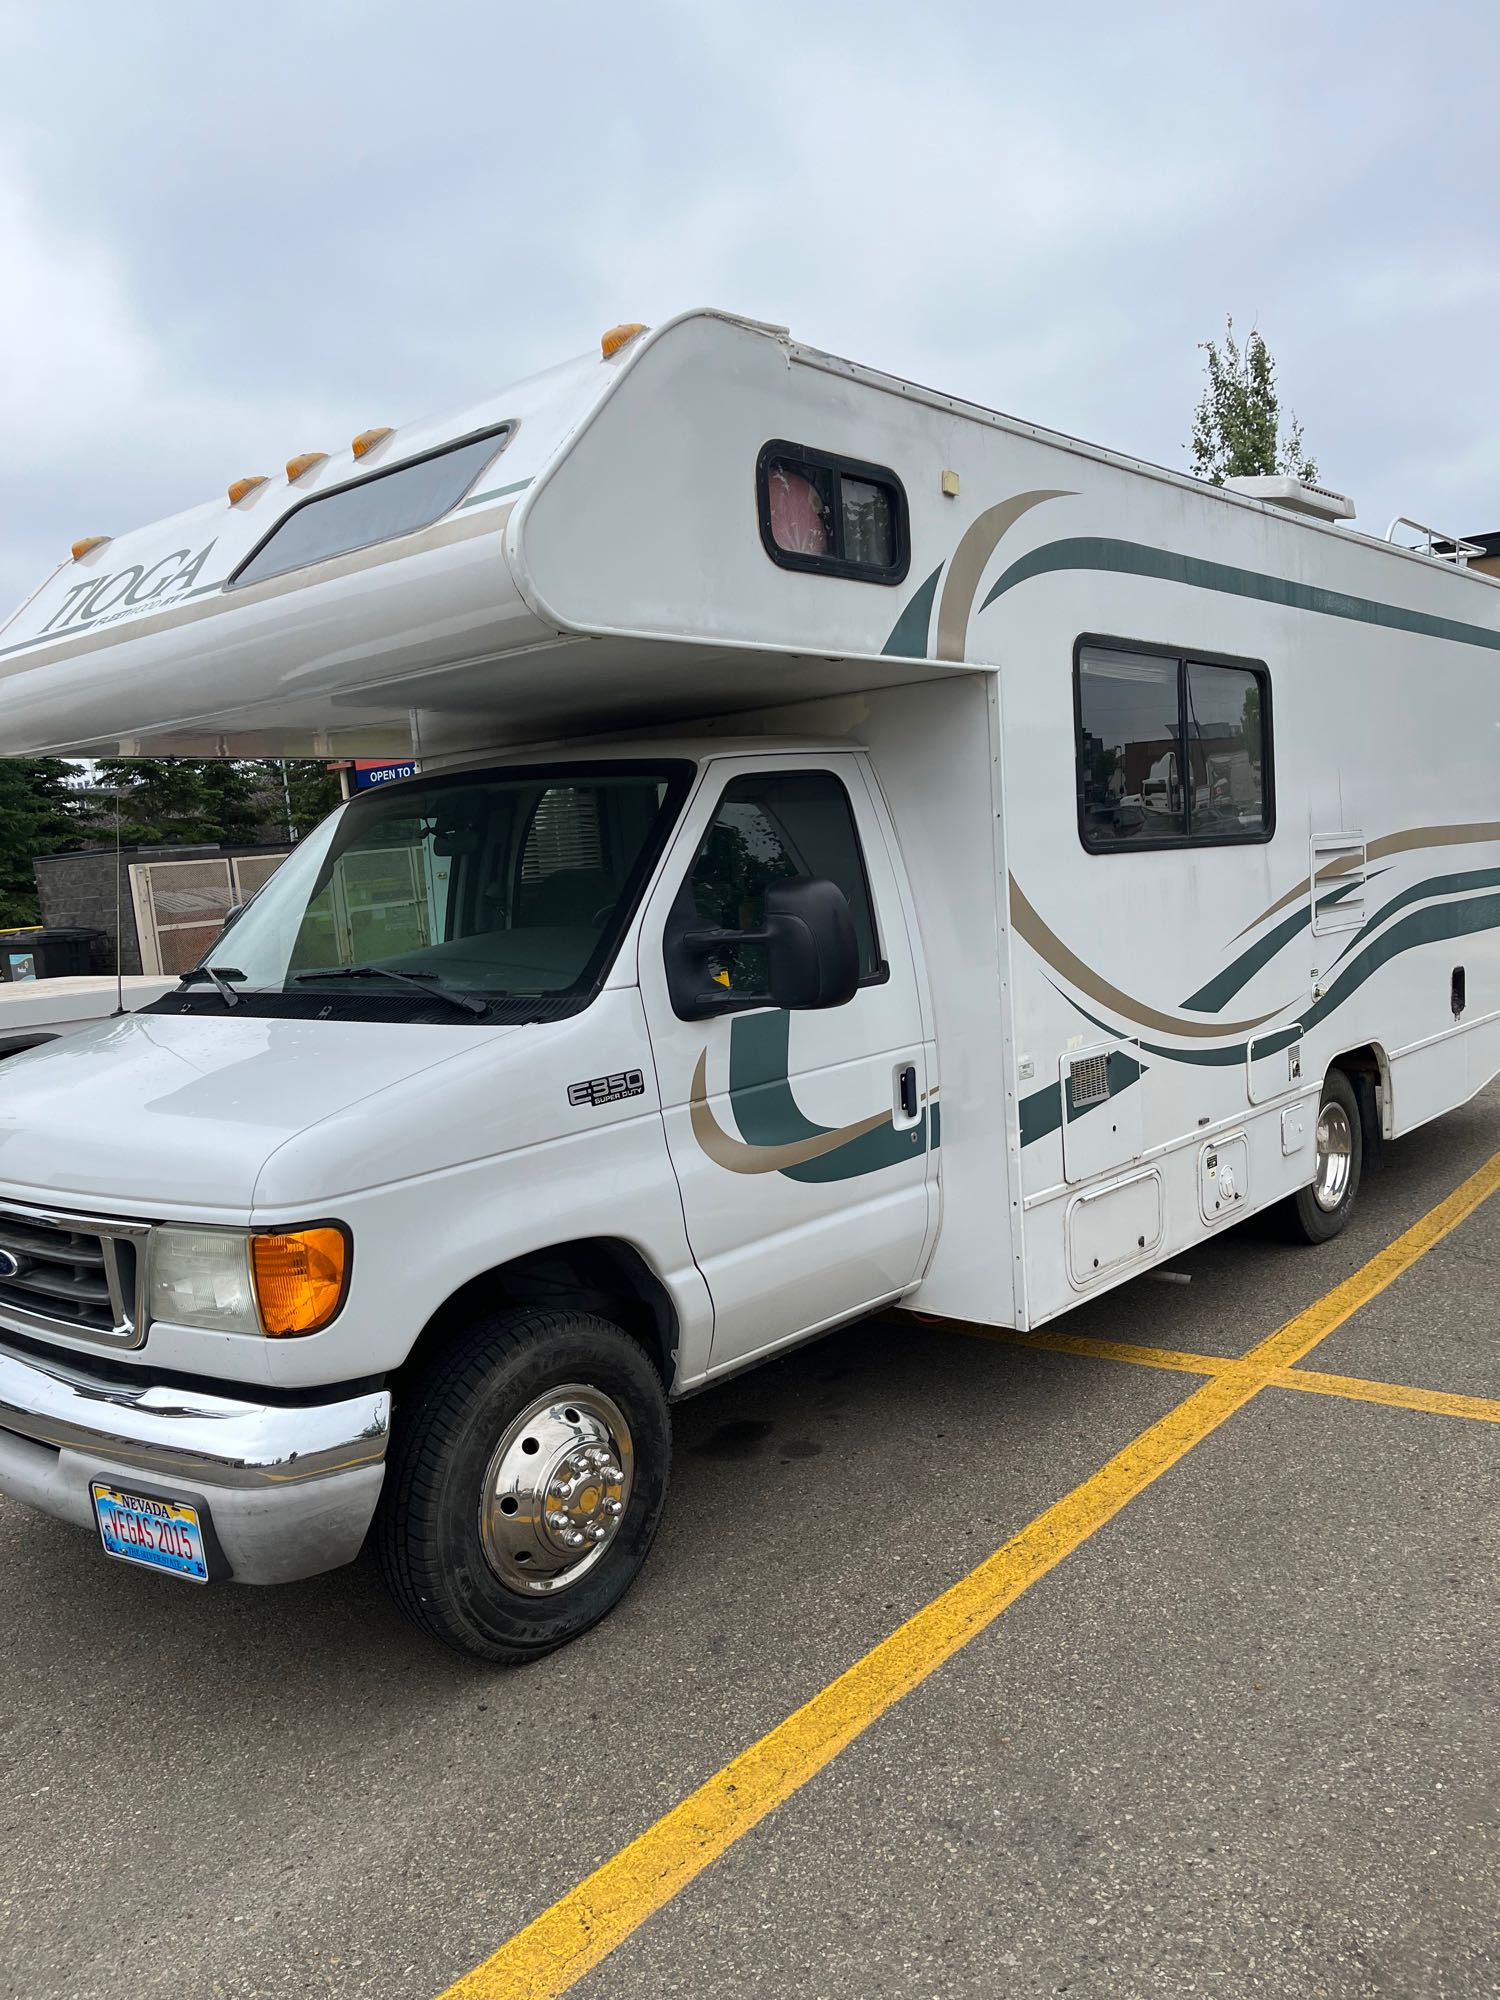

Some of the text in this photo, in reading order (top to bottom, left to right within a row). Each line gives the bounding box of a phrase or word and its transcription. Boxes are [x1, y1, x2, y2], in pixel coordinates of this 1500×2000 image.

[38, 536, 218, 634] TIOGA
[370, 769, 396, 782] OPEN
[397, 767, 411, 778] TO
[594, 1087, 642, 1104] SUPER DUTY
[121, 1494, 171, 1519] NEVADA
[109, 1508, 193, 1560] VEGAS 2015
